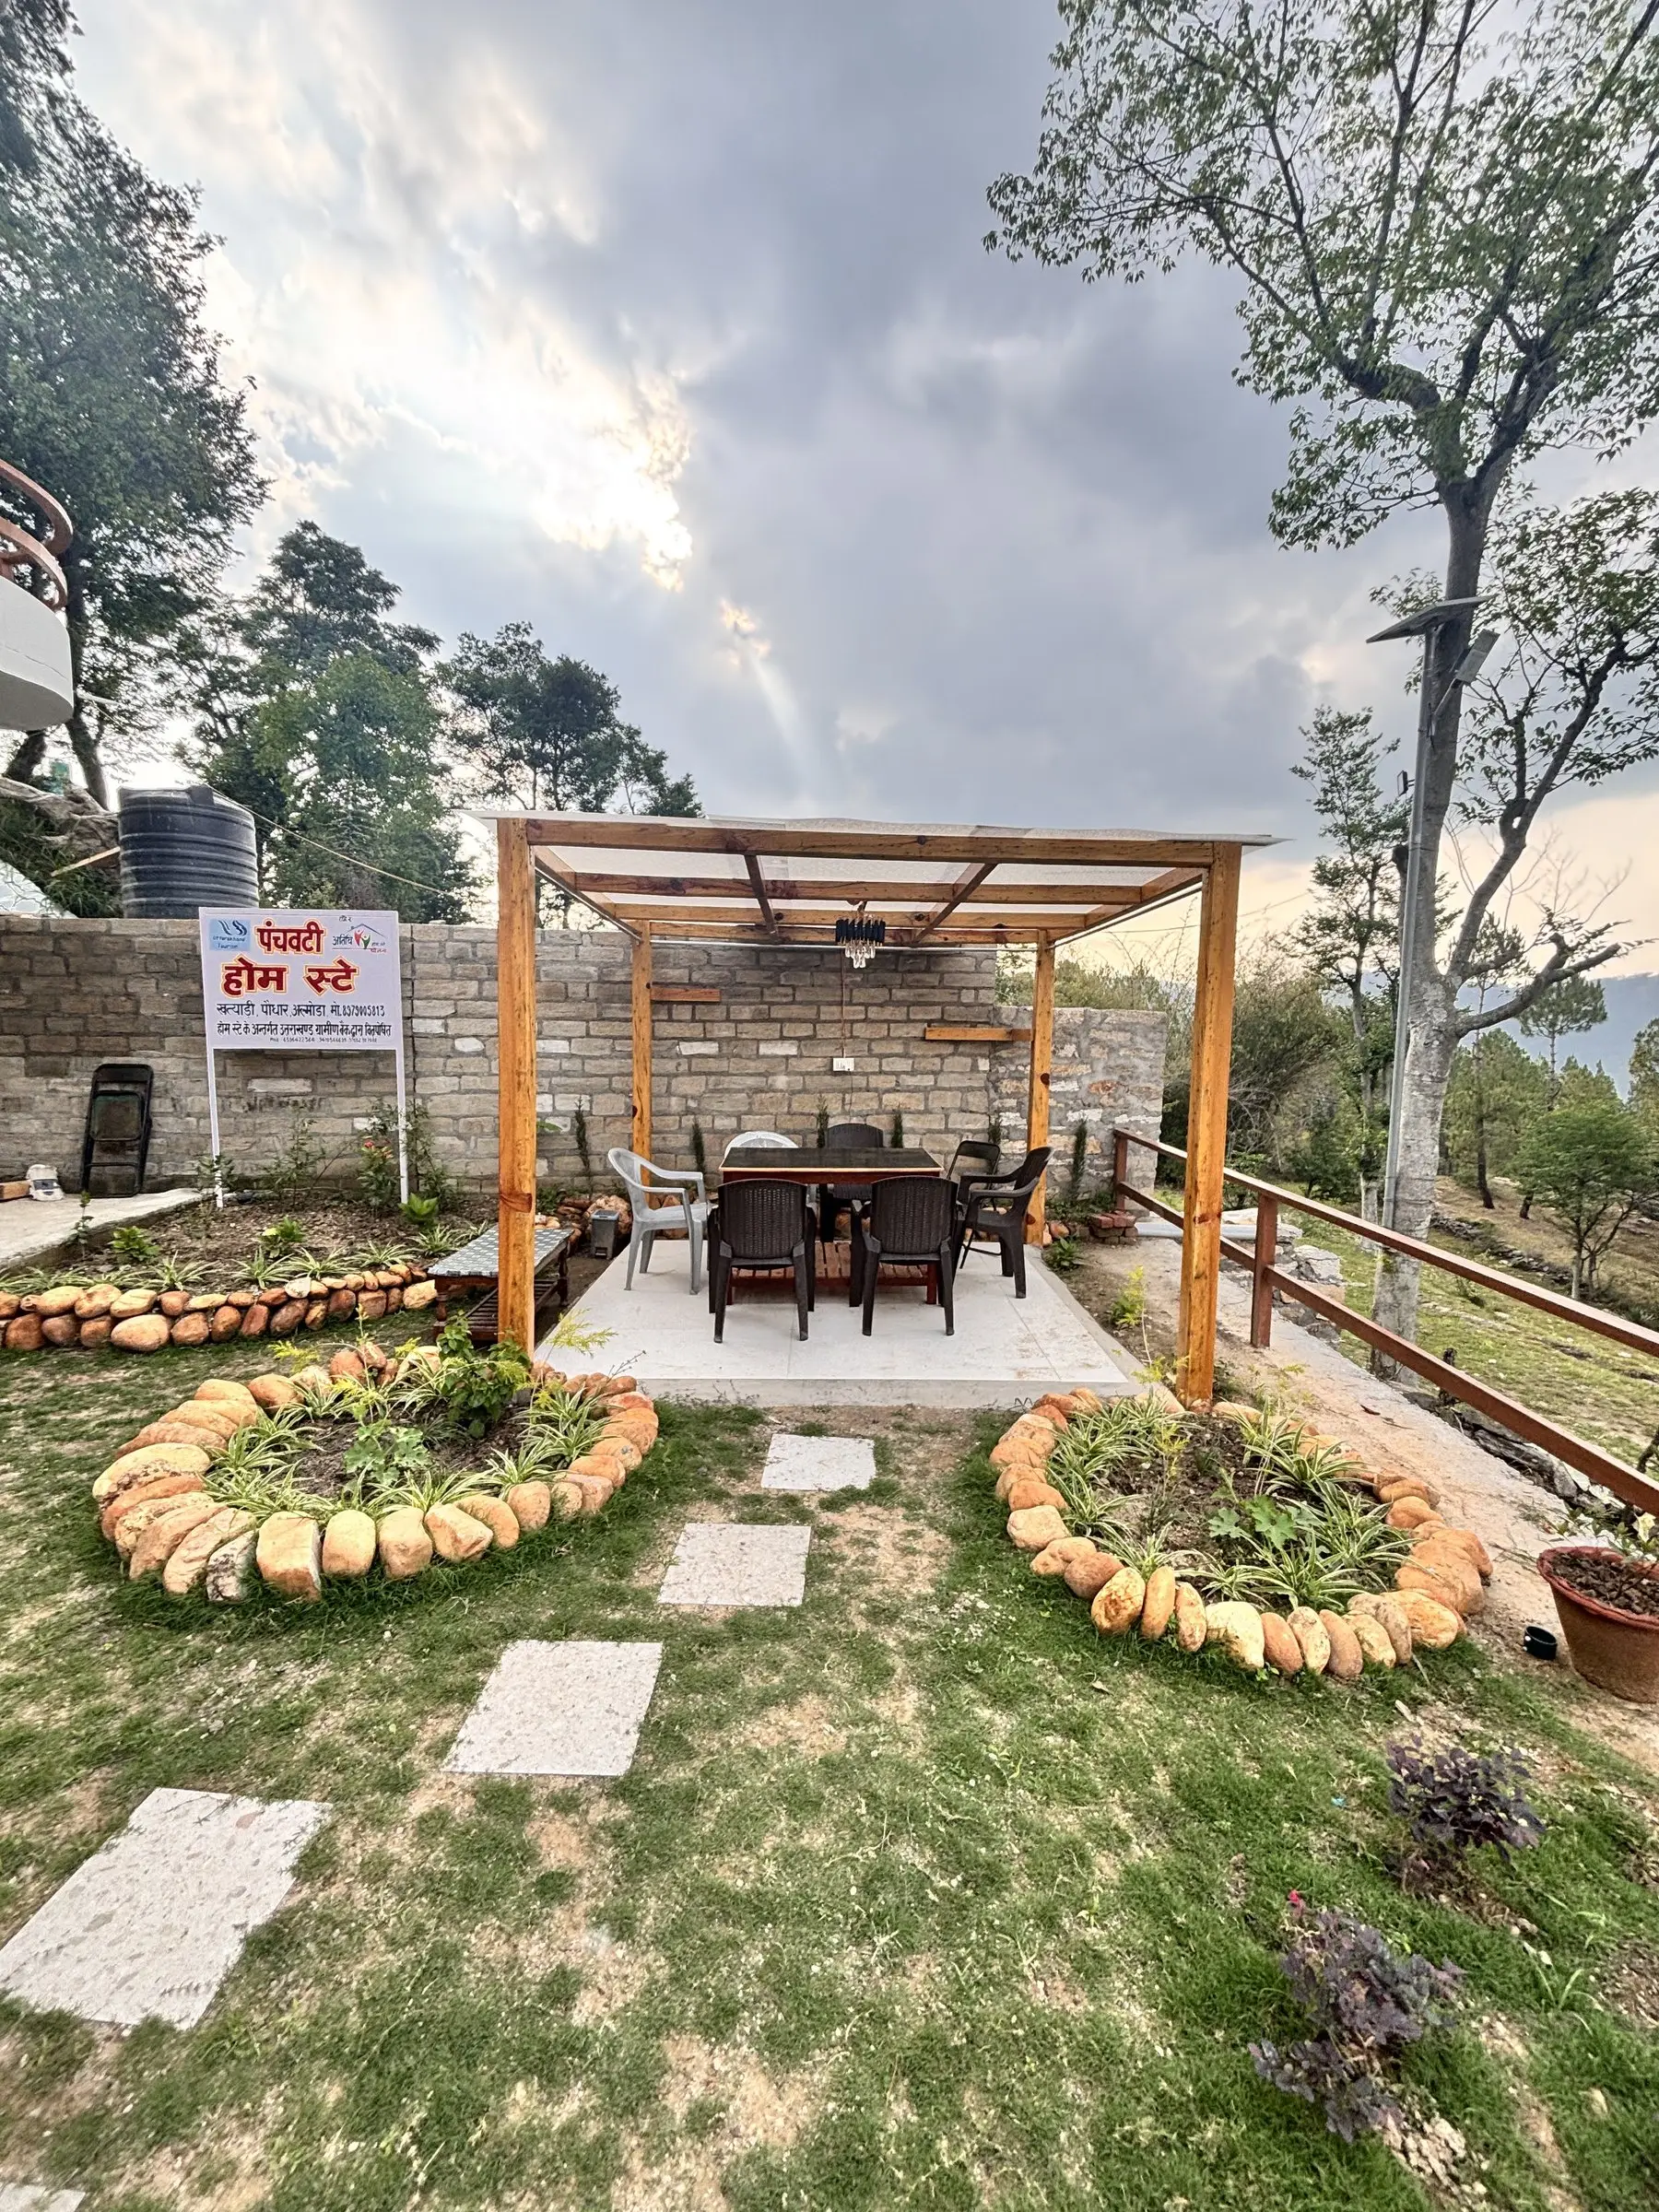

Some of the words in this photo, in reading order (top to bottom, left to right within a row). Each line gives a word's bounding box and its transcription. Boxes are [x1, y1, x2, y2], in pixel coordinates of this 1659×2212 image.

[256, 920, 324, 953] पंचवटी
[223, 957, 288, 996] होम
[304, 958, 358, 994] स्टे
[217, 1021, 230, 1036] होम
[232, 1021, 242, 1036] स्टे
[242, 1021, 251, 1036] के
[315, 1020, 339, 1036] ग्रामीण
